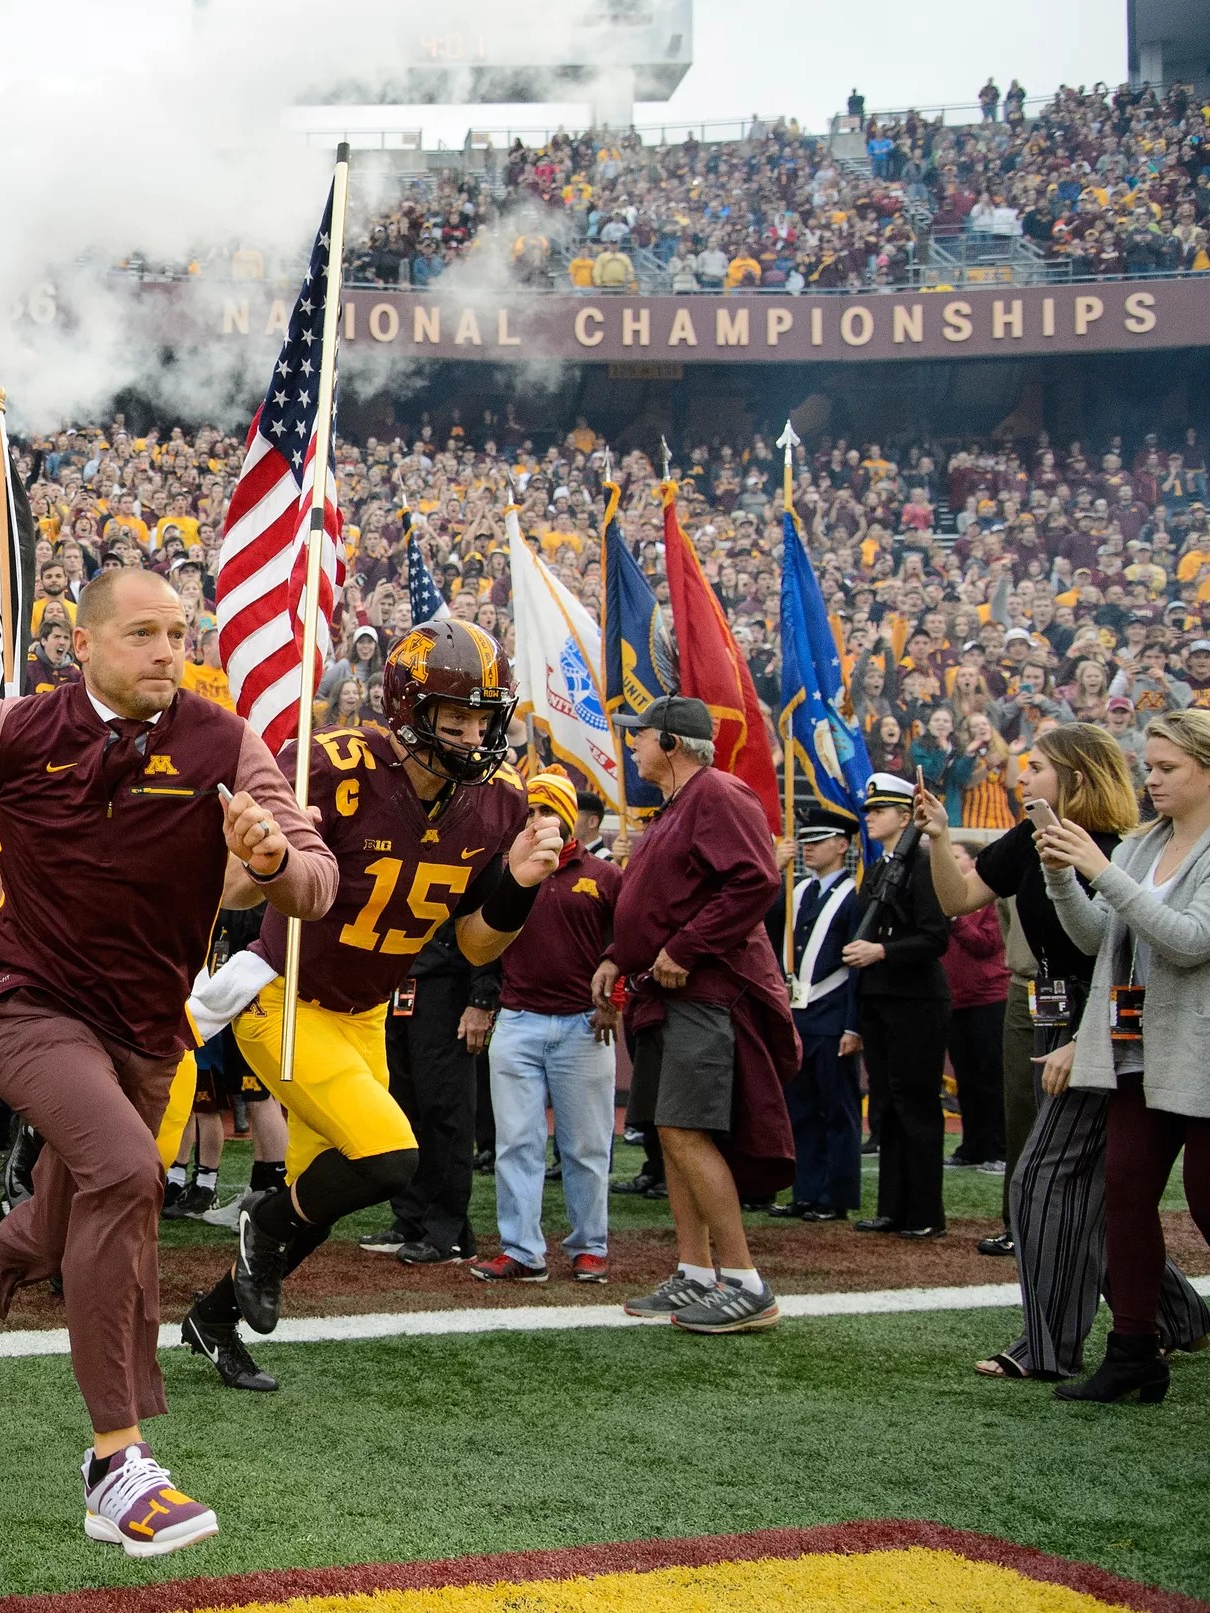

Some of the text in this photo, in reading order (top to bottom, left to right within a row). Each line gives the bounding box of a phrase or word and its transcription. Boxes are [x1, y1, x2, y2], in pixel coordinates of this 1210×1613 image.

[221, 292, 1158, 347] NAIONAL CHAMPIONSHIPS
[483, 689, 500, 698] ROW
[313, 728, 377, 771] 15
[144, 755, 180, 775] M
[335, 778, 361, 818] C
[421, 828, 440, 843] M
[340, 856, 473, 955] 15
[1058, 1001, 1067, 1012] F
[241, 1076, 263, 1092] M
